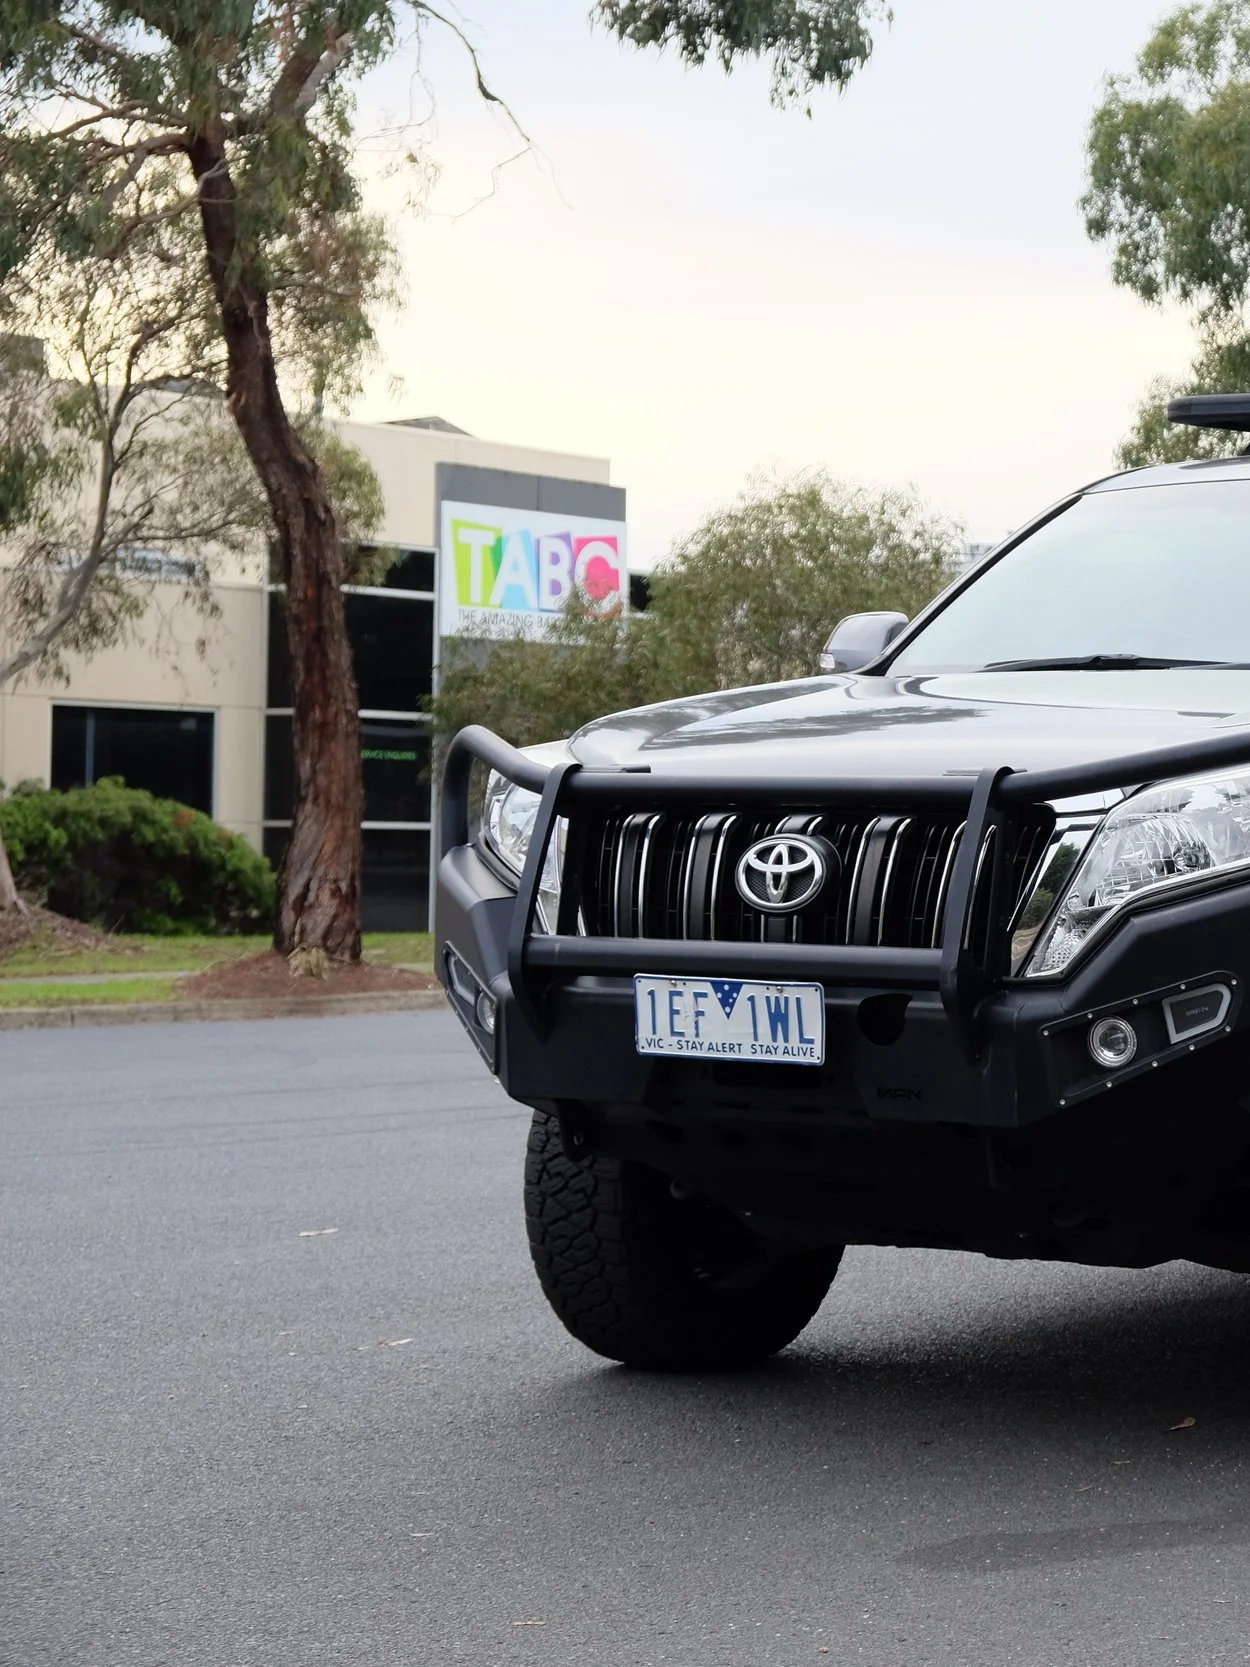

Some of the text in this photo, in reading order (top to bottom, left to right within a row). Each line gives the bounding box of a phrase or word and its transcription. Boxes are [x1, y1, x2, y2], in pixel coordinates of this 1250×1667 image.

[456, 526, 620, 614] TABC
[458, 608, 477, 622] THE
[481, 612, 534, 629] AMAZING
[647, 987, 815, 1045] 1EF 1WL
[645, 1037, 664, 1049] VIC
[676, 1039, 704, 1051] STAY
[707, 1041, 743, 1054] ALERT
[750, 1043, 779, 1056] STAY
[782, 1045, 815, 1058] ALIVE
